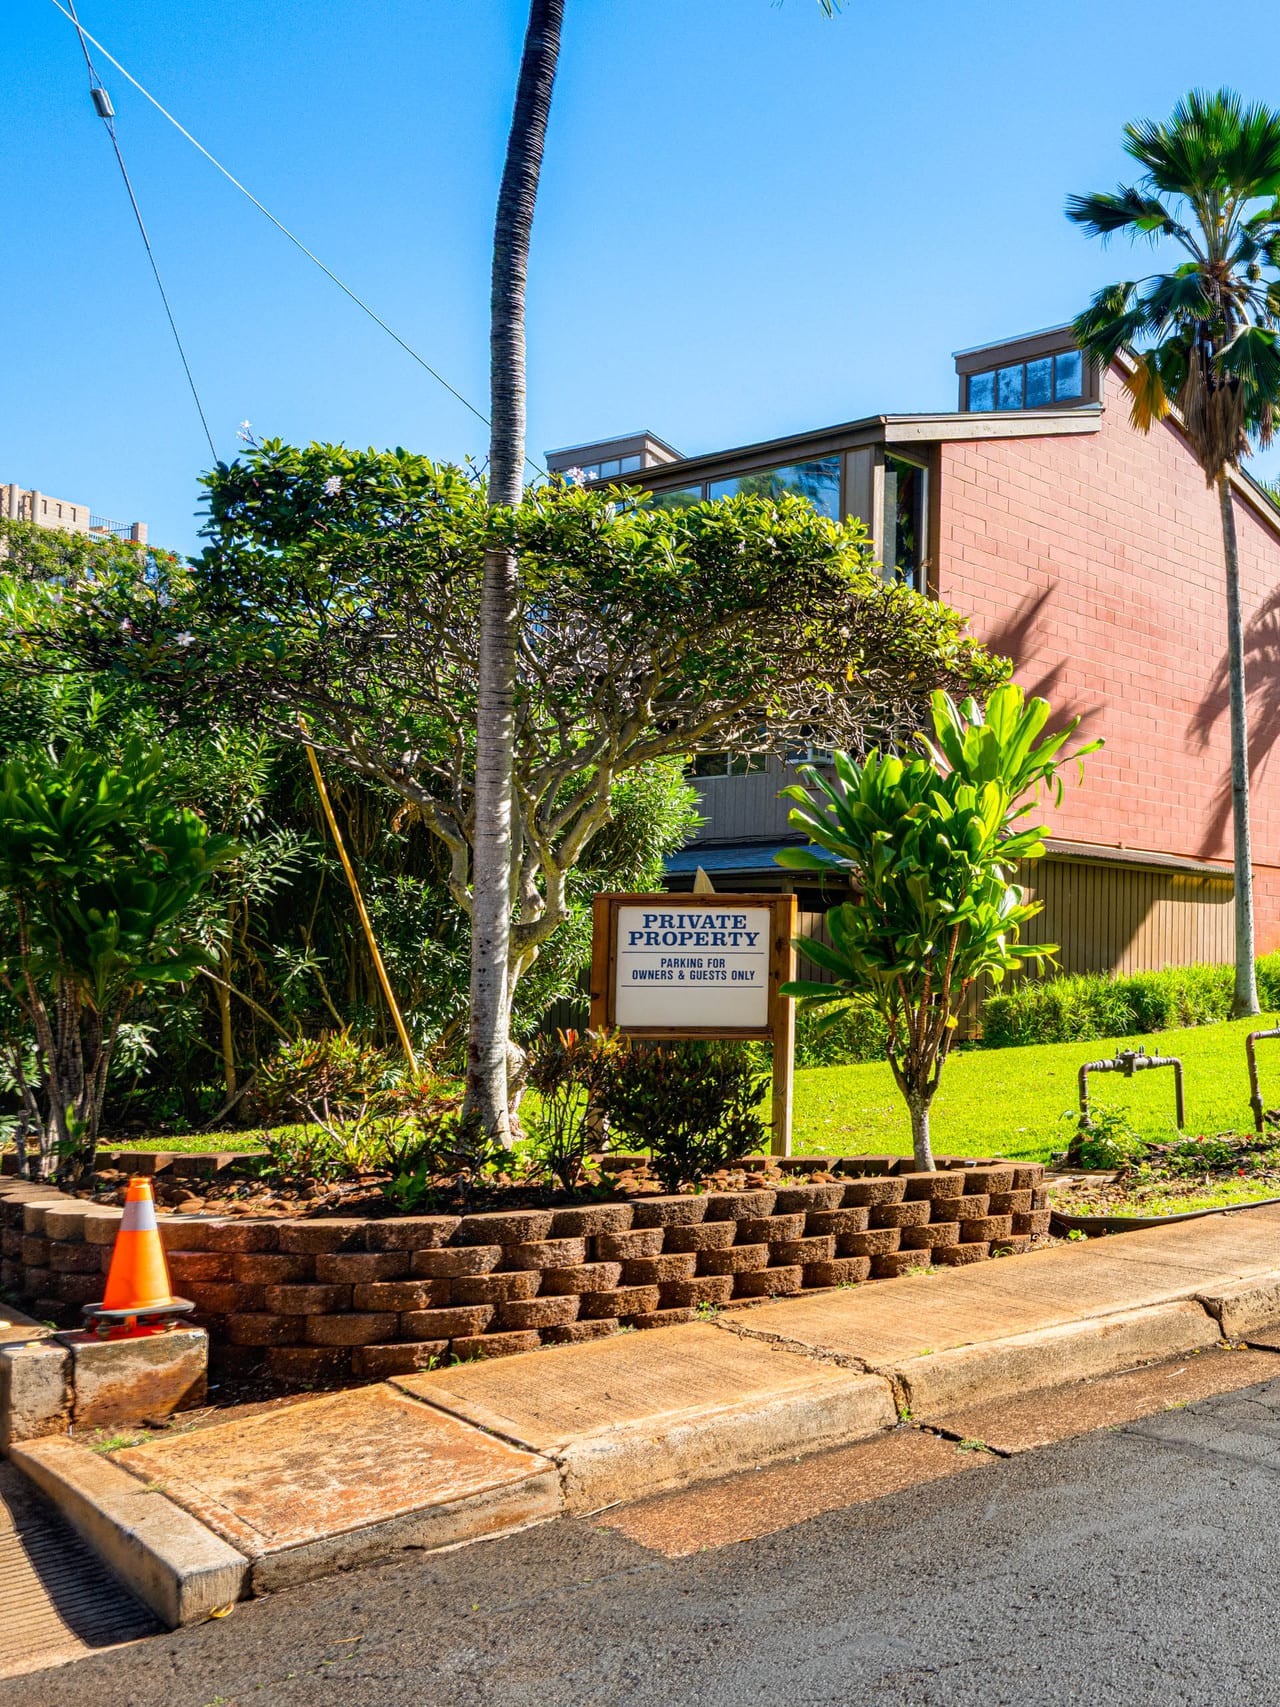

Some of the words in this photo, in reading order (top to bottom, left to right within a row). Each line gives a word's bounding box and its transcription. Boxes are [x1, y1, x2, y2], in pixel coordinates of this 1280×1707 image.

[642, 914, 747, 929] PRIVATE
[628, 931, 760, 947] PROPERTY
[660, 958, 703, 968] PARKING
[707, 958, 726, 968] FOR
[632, 970, 674, 980] OWNERS
[678, 970, 685, 980] &
[689, 970, 727, 980] GUESTS
[731, 970, 756, 980] ONLY
